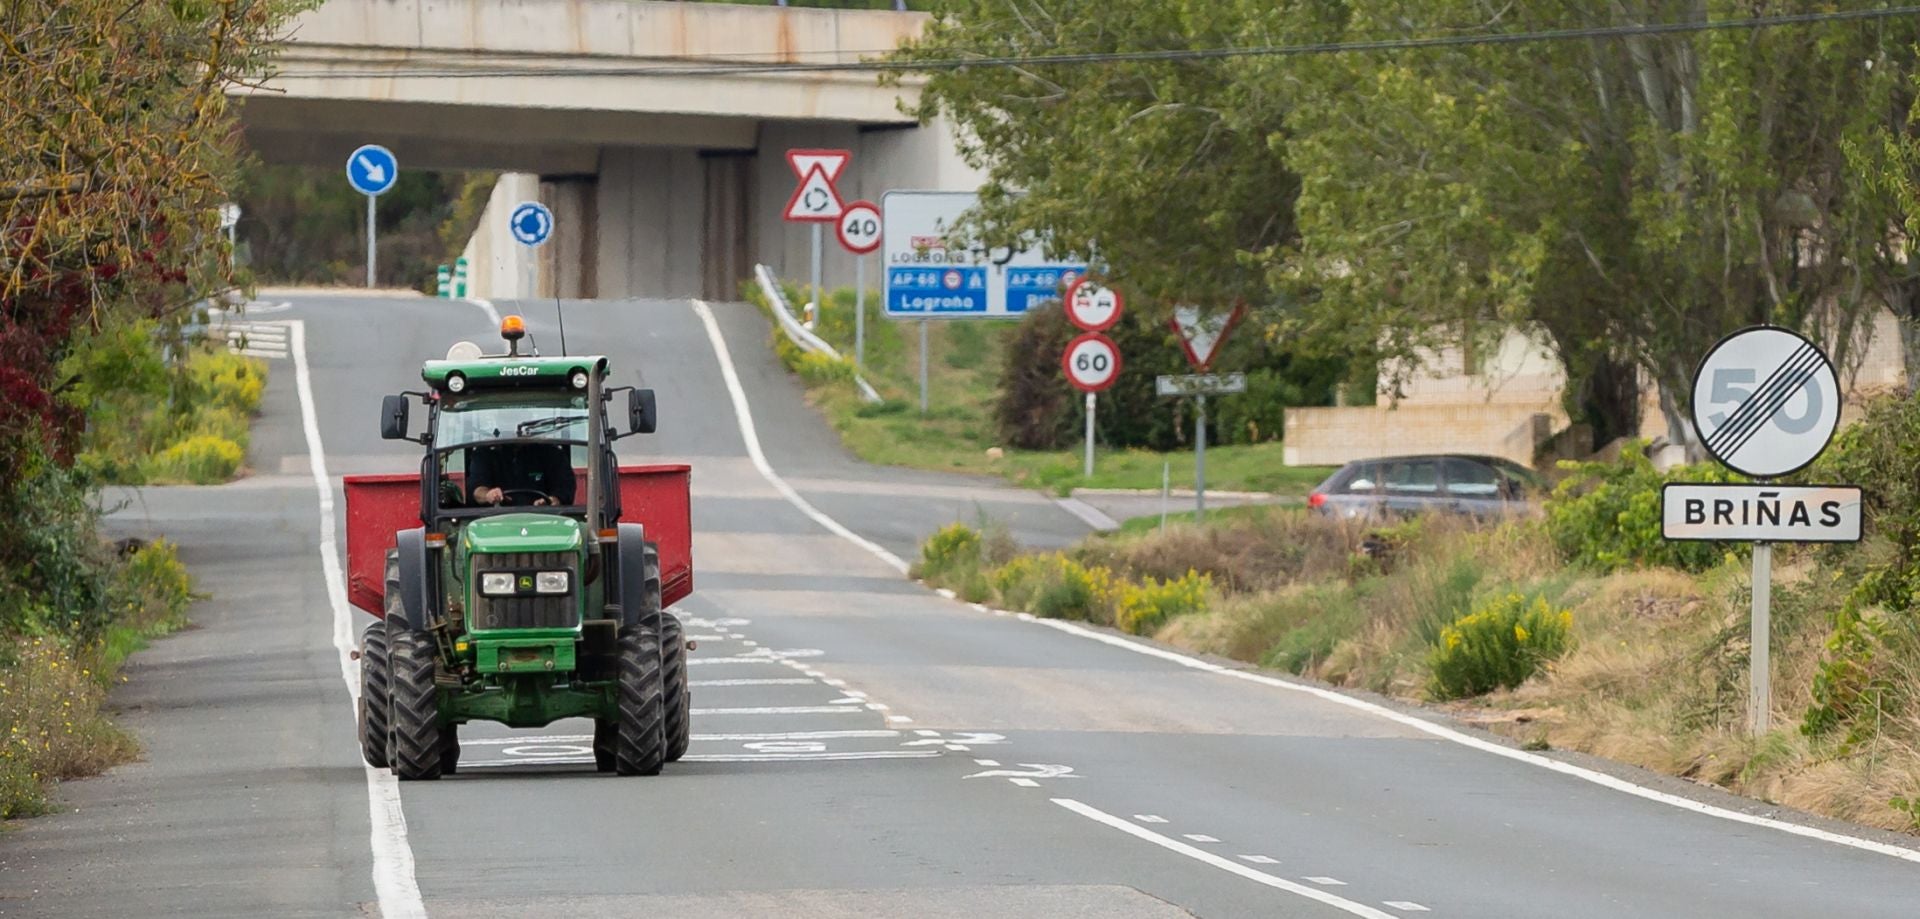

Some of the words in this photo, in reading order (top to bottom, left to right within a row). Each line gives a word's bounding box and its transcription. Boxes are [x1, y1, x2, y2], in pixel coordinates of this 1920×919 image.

[846, 219, 877, 236] 40
[499, 365, 540, 377] JesCar
[1076, 353, 1108, 372] 60
[1707, 368, 1824, 435] 50
[1685, 491, 1842, 528] BRIÑAS
